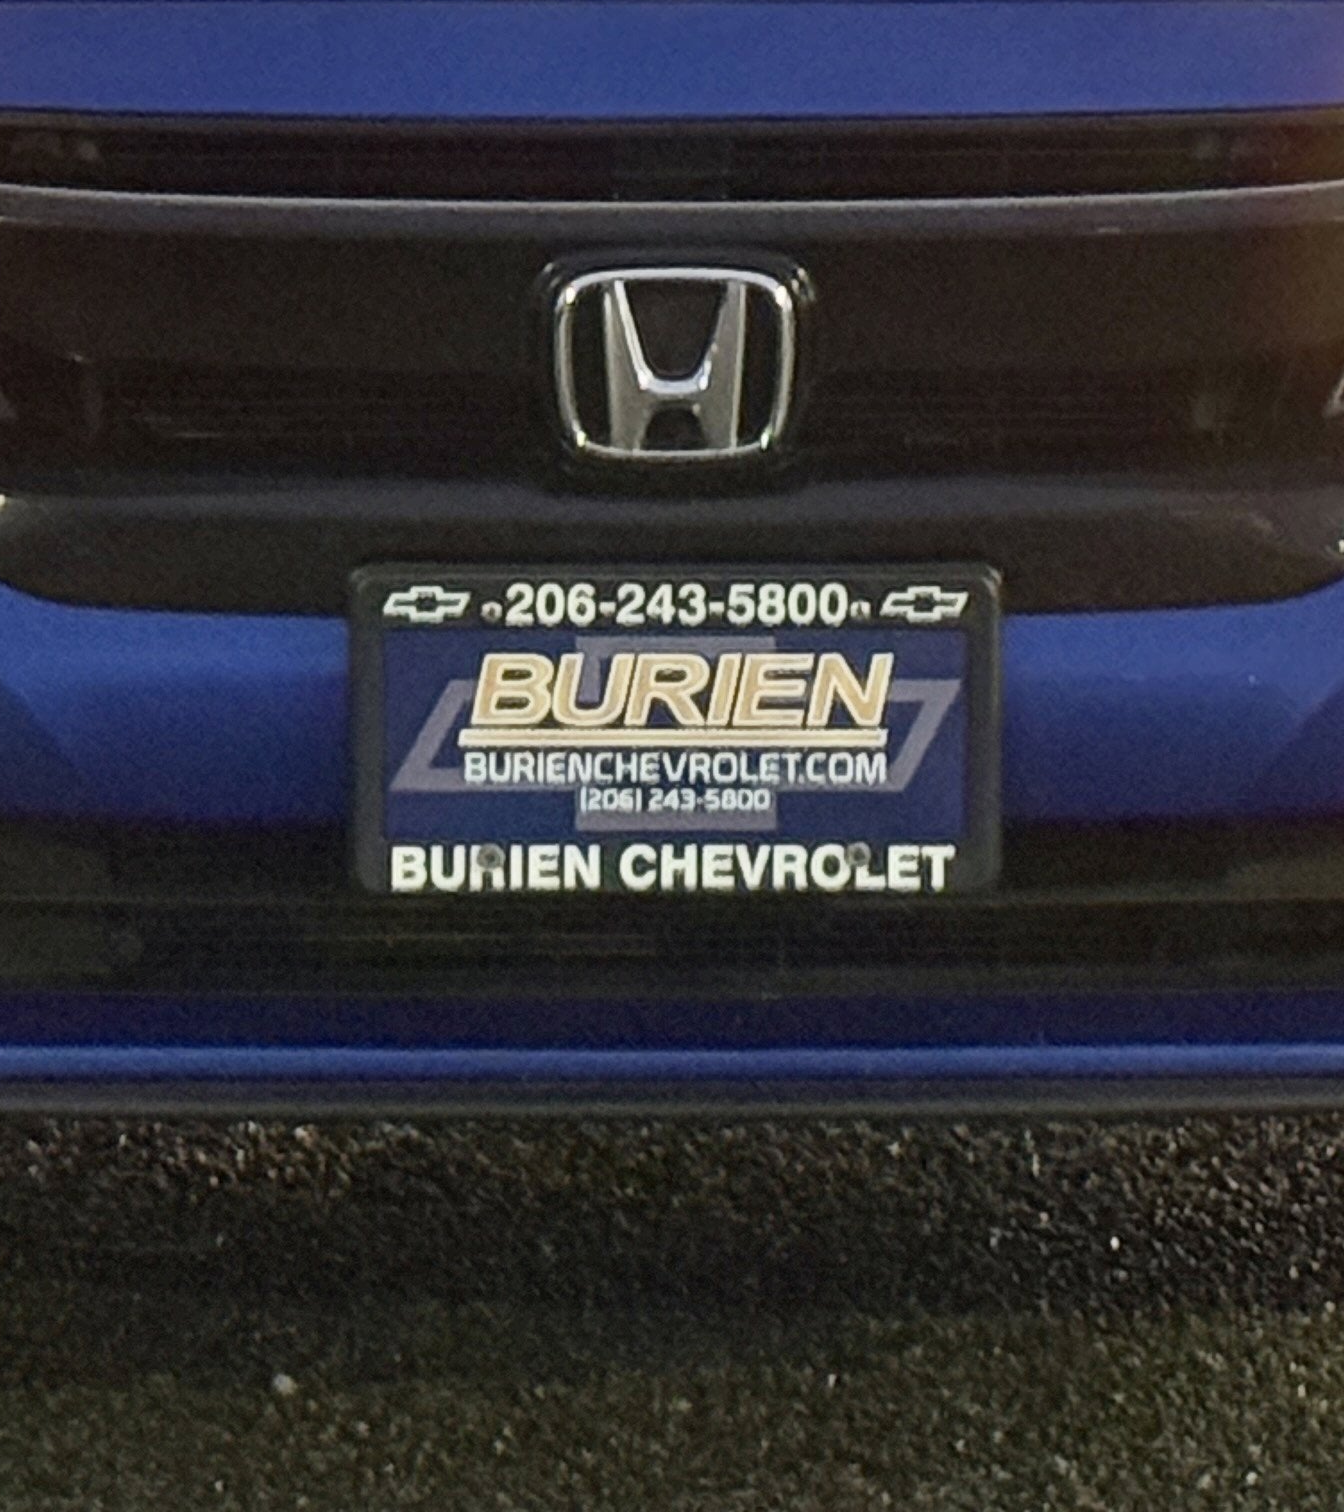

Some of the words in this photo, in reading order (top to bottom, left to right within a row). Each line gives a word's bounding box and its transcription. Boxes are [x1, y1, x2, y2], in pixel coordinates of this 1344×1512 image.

[505, 583, 849, 626] 206-243-5800
[470, 653, 894, 726] BURIEN
[463, 752, 888, 784] BURIENCHEVROLET.COM
[580, 789, 642, 812] (206)
[648, 789, 770, 811] 243-5800
[391, 845, 601, 890] BURIEN
